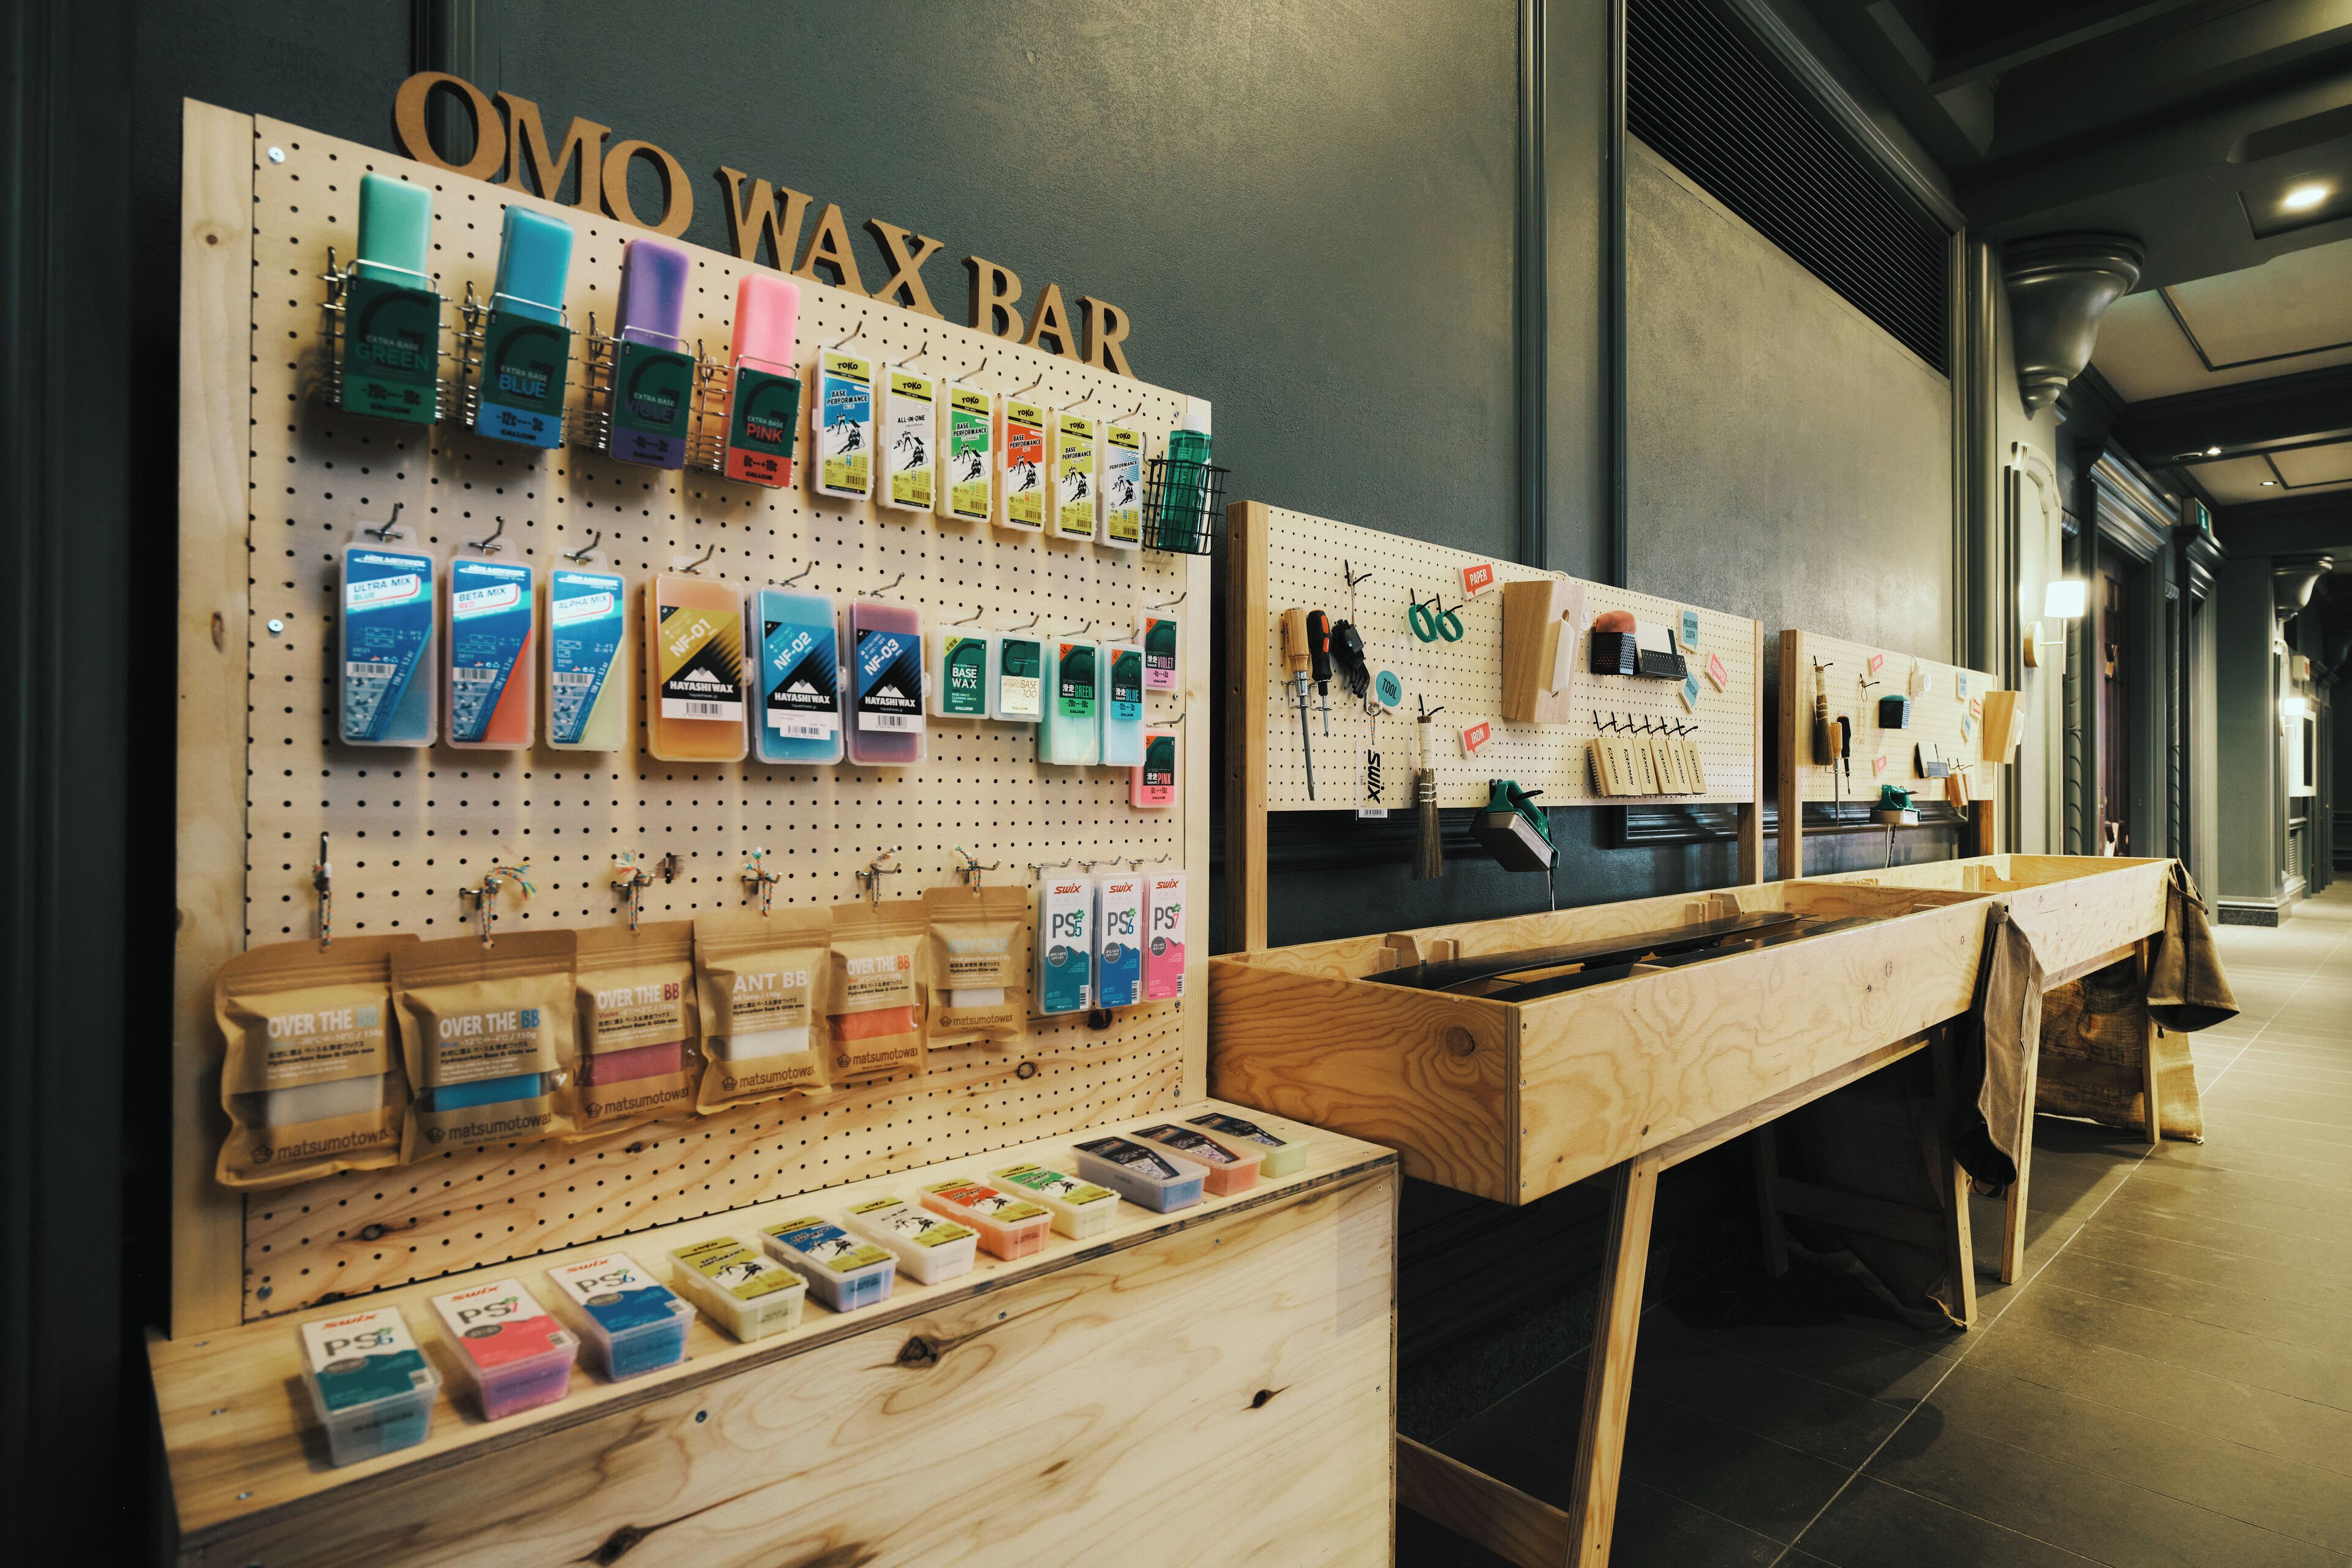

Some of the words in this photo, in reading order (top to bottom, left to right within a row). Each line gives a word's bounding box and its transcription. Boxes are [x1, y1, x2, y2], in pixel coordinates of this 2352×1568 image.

[394, 71, 693, 239] OMO
[714, 165, 945, 318] WAX
[960, 255, 1140, 379] BAR
[366, 334, 395, 347] EXTRA
[397, 339, 420, 352] BASE
[355, 342, 429, 371] GREEN
[501, 365, 526, 377] EXTRA
[527, 371, 548, 382] BASE
[837, 362, 858, 371] TOKO
[499, 374, 548, 398] BLUE
[902, 382, 922, 390] TOKO
[634, 392, 657, 403] EXTRA
[657, 397, 676, 407] BASE
[827, 395, 868, 405] PERFORMANCE
[625, 401, 682, 423] VIOLET
[897, 415, 925, 423] ALL-IN-ONE
[747, 415, 767, 425] EXTRA
[767, 420, 784, 429] BASE
[746, 423, 783, 443] PINK
[953, 428, 987, 437] PERFORMANCE
[1010, 439, 1041, 448] PERFORMANCE
[1062, 451, 1091, 460] PERFORMANCE
[1109, 460, 1137, 470] PERFORMANCE
[1469, 568, 1488, 586] PAPER
[354, 580, 387, 592] ULTRA
[391, 577, 411, 587] MIX
[459, 591, 483, 601] BETA
[487, 587, 505, 597] MIX
[559, 598, 587, 609] ALPHA
[590, 594, 608, 603] MIX
[1683, 618, 1698, 630] POLISHING
[669, 617, 711, 657] NF-01
[1686, 630, 1695, 639] CLOTH
[774, 631, 812, 671] NF-02
[864, 638, 899, 676] NF-03
[1147, 655, 1158, 663] 滑走
[1158, 656, 1174, 669] VIOLET
[952, 667, 977, 679] BASE
[952, 678, 976, 689] WAX
[1020, 680, 1038, 689] BASE
[1062, 684, 1074, 693] 滑走
[1382, 677, 1397, 700] TOOL
[1686, 678, 1698, 698] BRUSH
[1023, 690, 1038, 699] 100
[1075, 685, 1093, 698] GREEN
[1115, 688, 1126, 696] 滑走
[1126, 688, 1139, 702] BLUE
[1471, 727, 1485, 745] IRON
[1158, 773, 1171, 785] PINK
[948, 940, 975, 954] VERY
[847, 957, 875, 975] OVER
[875, 956, 895, 973] THE
[897, 955, 910, 970] BB
[733, 973, 777, 993] ANT
[783, 970, 808, 988] BB
[597, 988, 633, 1009] OVER
[635, 985, 662, 1005] THE
[664, 982, 679, 1001] BB
[268, 1012, 316, 1038] OVER
[318, 1009, 353, 1032] THE
[357, 1007, 378, 1027] BB
[439, 1015, 483, 1039] OVER
[485, 1011, 517, 1033] THE
[521, 1009, 540, 1029] BB
[953, 1014, 1013, 1026] matsumotowax
[853, 1047, 918, 1065] matsumotowax
